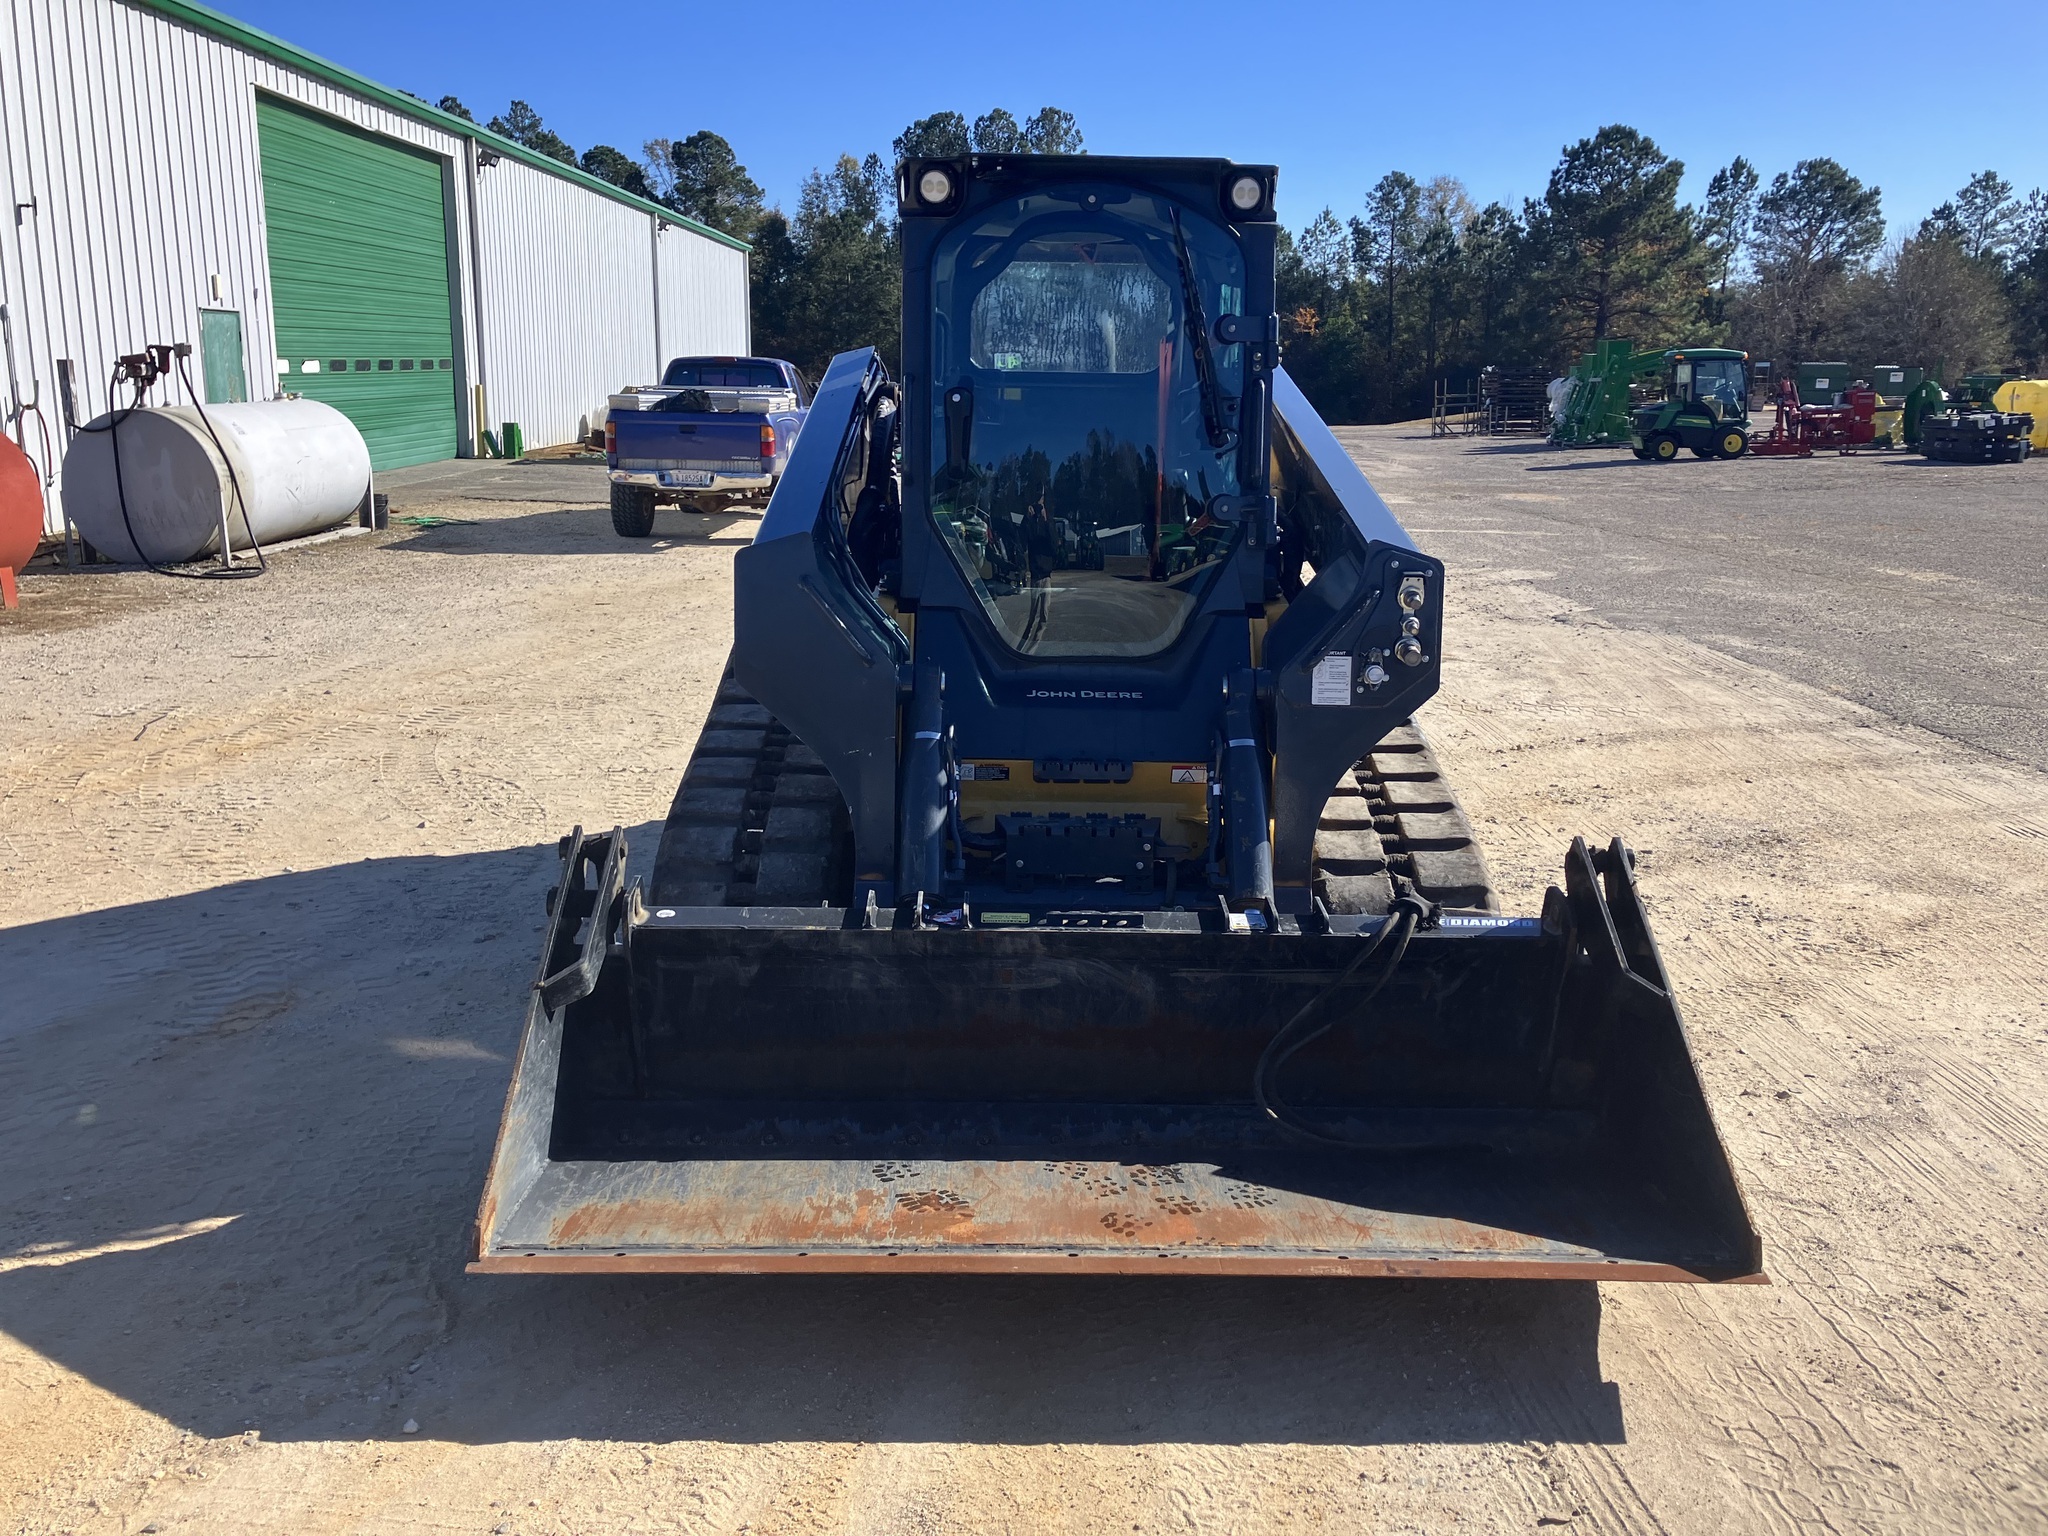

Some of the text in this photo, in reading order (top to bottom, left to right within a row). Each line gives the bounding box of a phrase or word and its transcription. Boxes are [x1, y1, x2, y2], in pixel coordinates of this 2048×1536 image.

[1026, 689, 1143, 699] JOHN DEERE
[1450, 918, 1534, 927] DIAMOND
